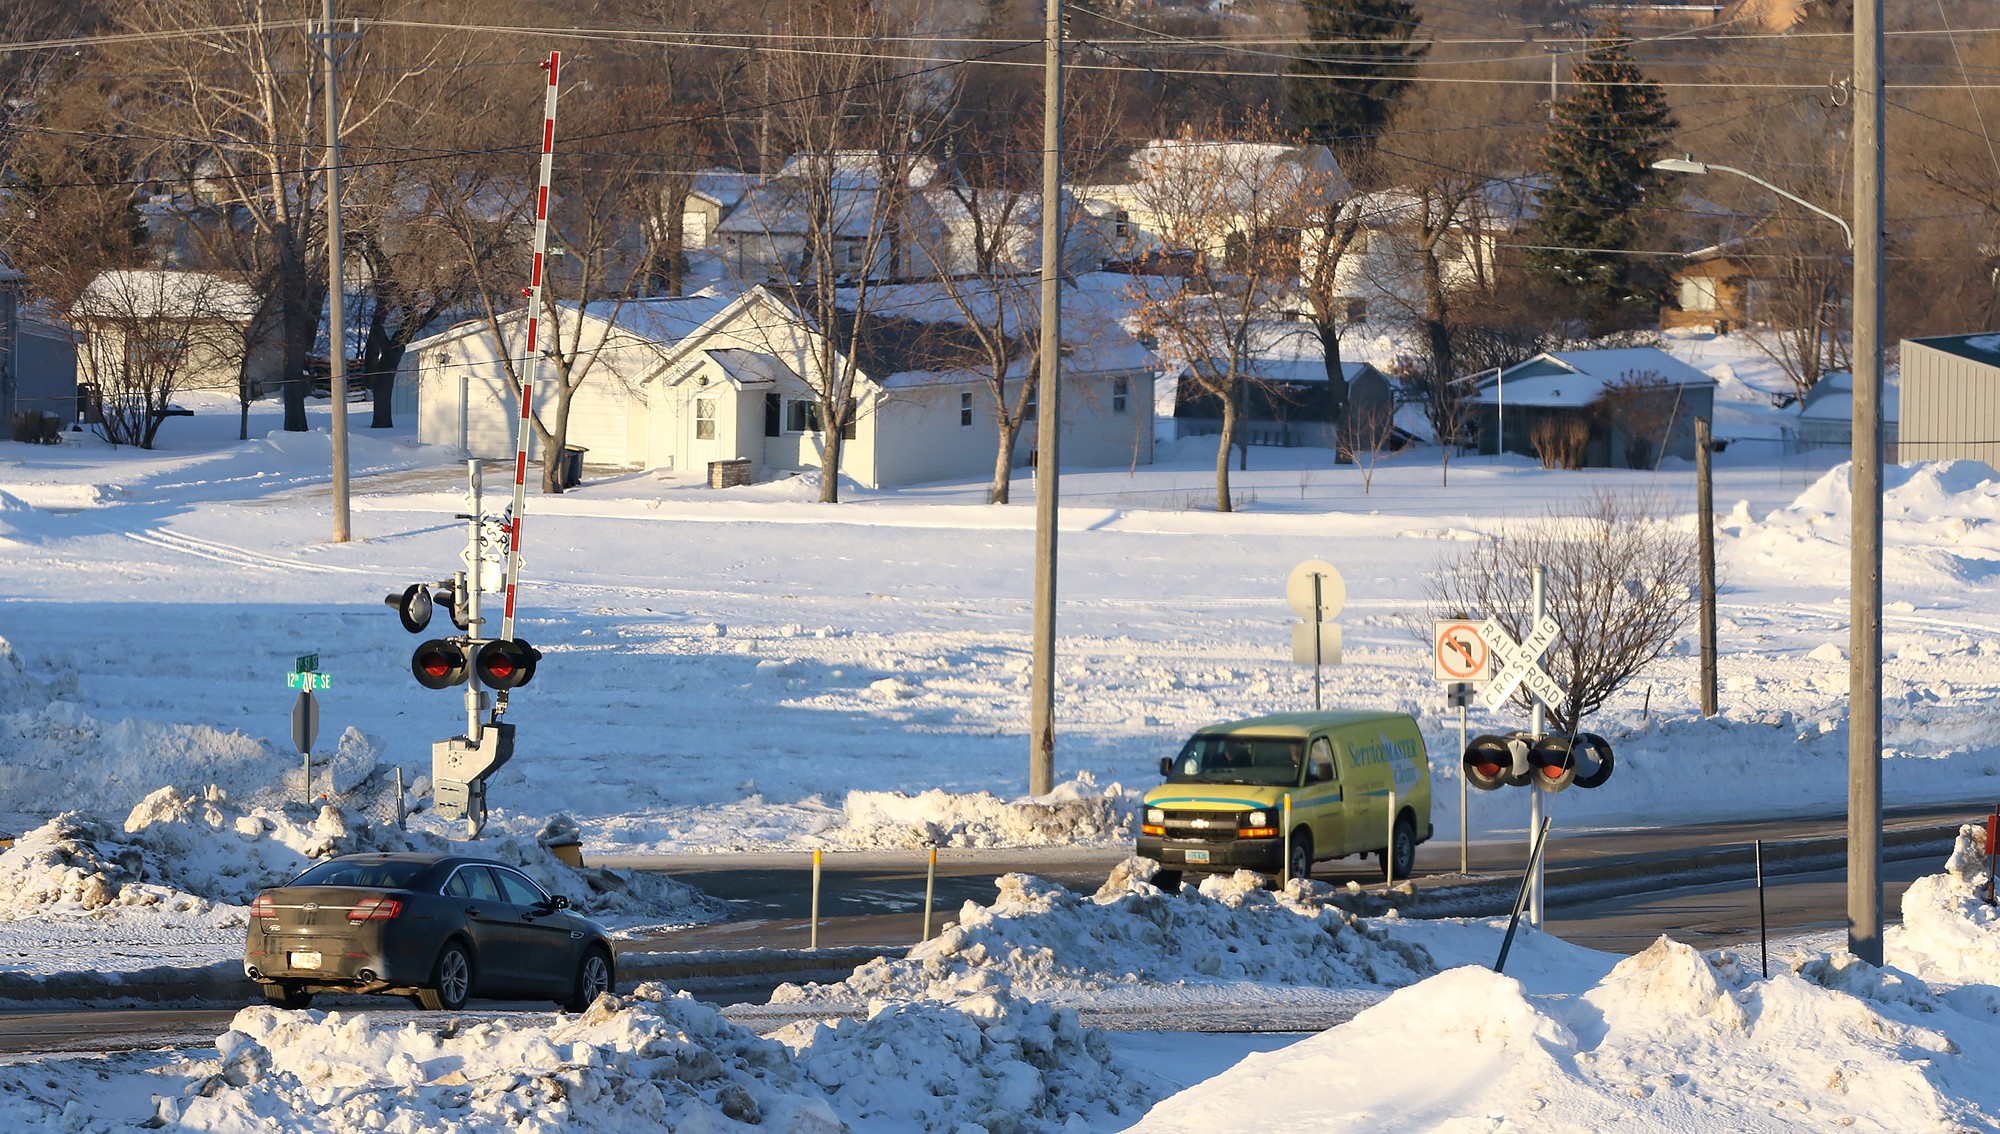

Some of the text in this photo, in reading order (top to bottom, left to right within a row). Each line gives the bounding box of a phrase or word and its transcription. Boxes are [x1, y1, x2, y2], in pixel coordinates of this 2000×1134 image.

[303, 673, 317, 689] AVE
[320, 674, 331, 689] SE
[1485, 621, 1555, 706] CROSSING
